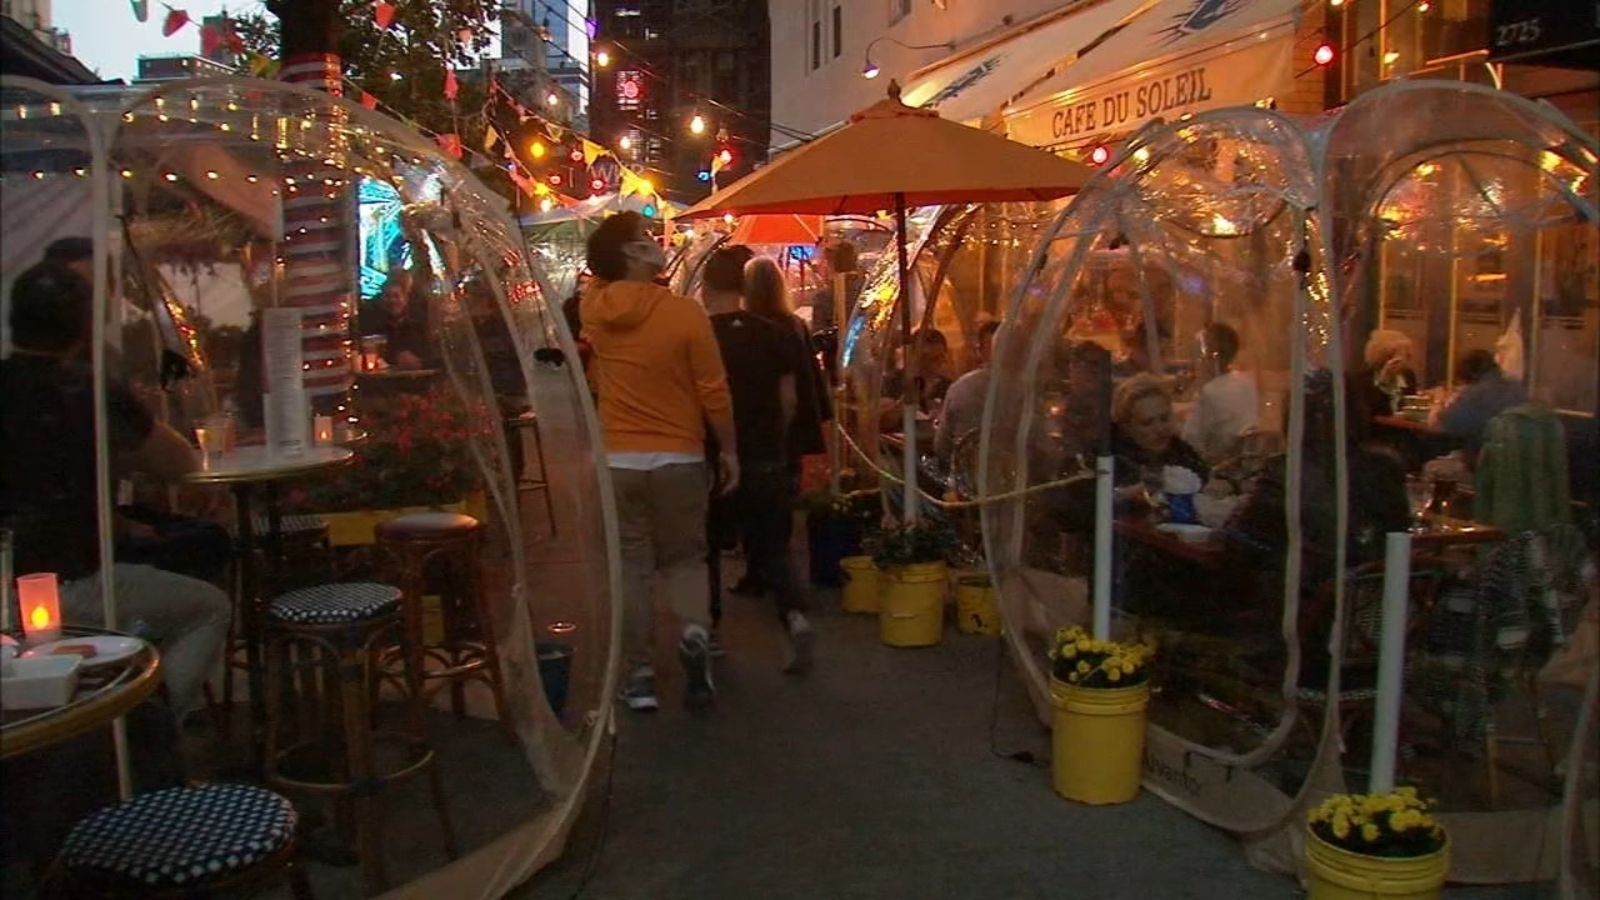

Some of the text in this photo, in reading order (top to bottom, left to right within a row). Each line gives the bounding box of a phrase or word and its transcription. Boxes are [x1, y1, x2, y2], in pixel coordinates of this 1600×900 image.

[1495, 17, 1540, 46] 2725
[1052, 68, 1212, 138] CAFE DU SOLEIL
